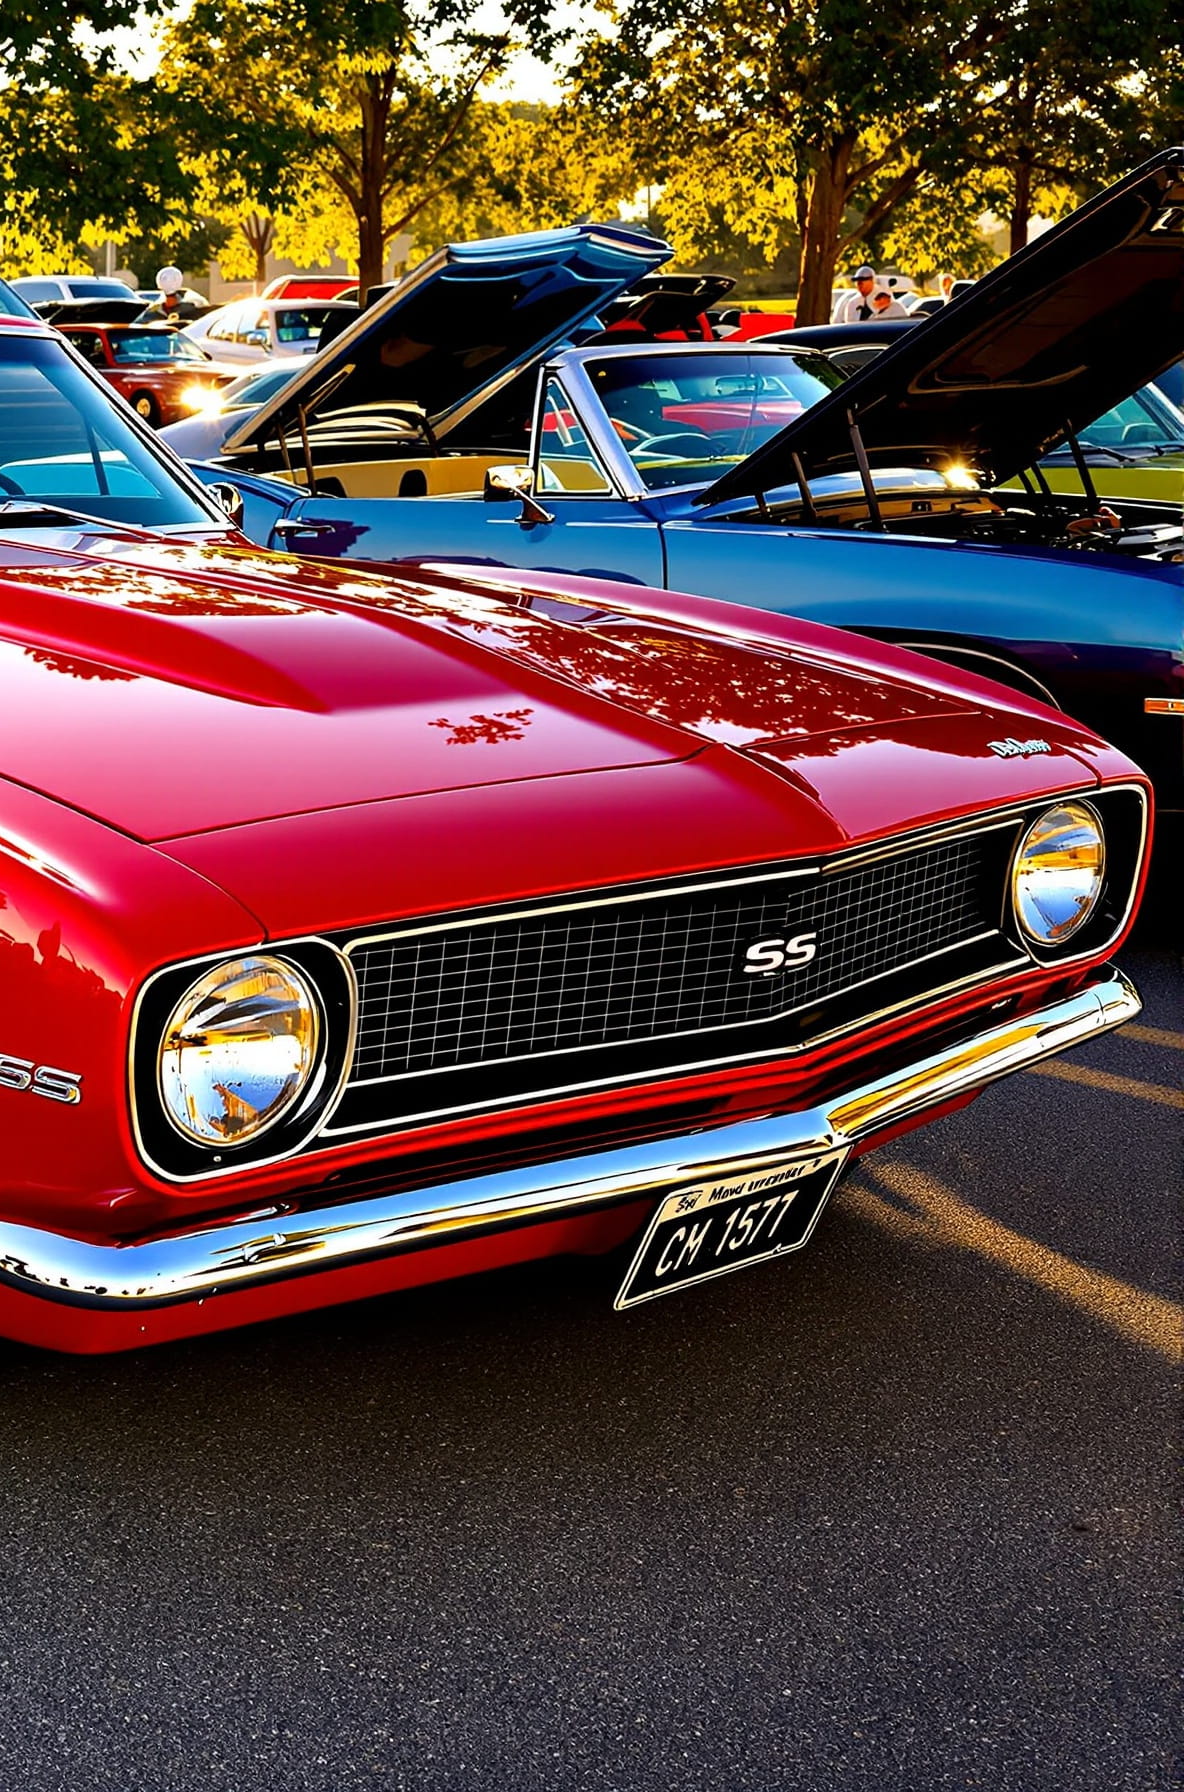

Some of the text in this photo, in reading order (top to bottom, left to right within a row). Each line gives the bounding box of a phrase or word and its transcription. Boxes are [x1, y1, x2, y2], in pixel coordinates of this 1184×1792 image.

[743, 931, 817, 973] SS
[655, 1189, 800, 1277] CM 1577
